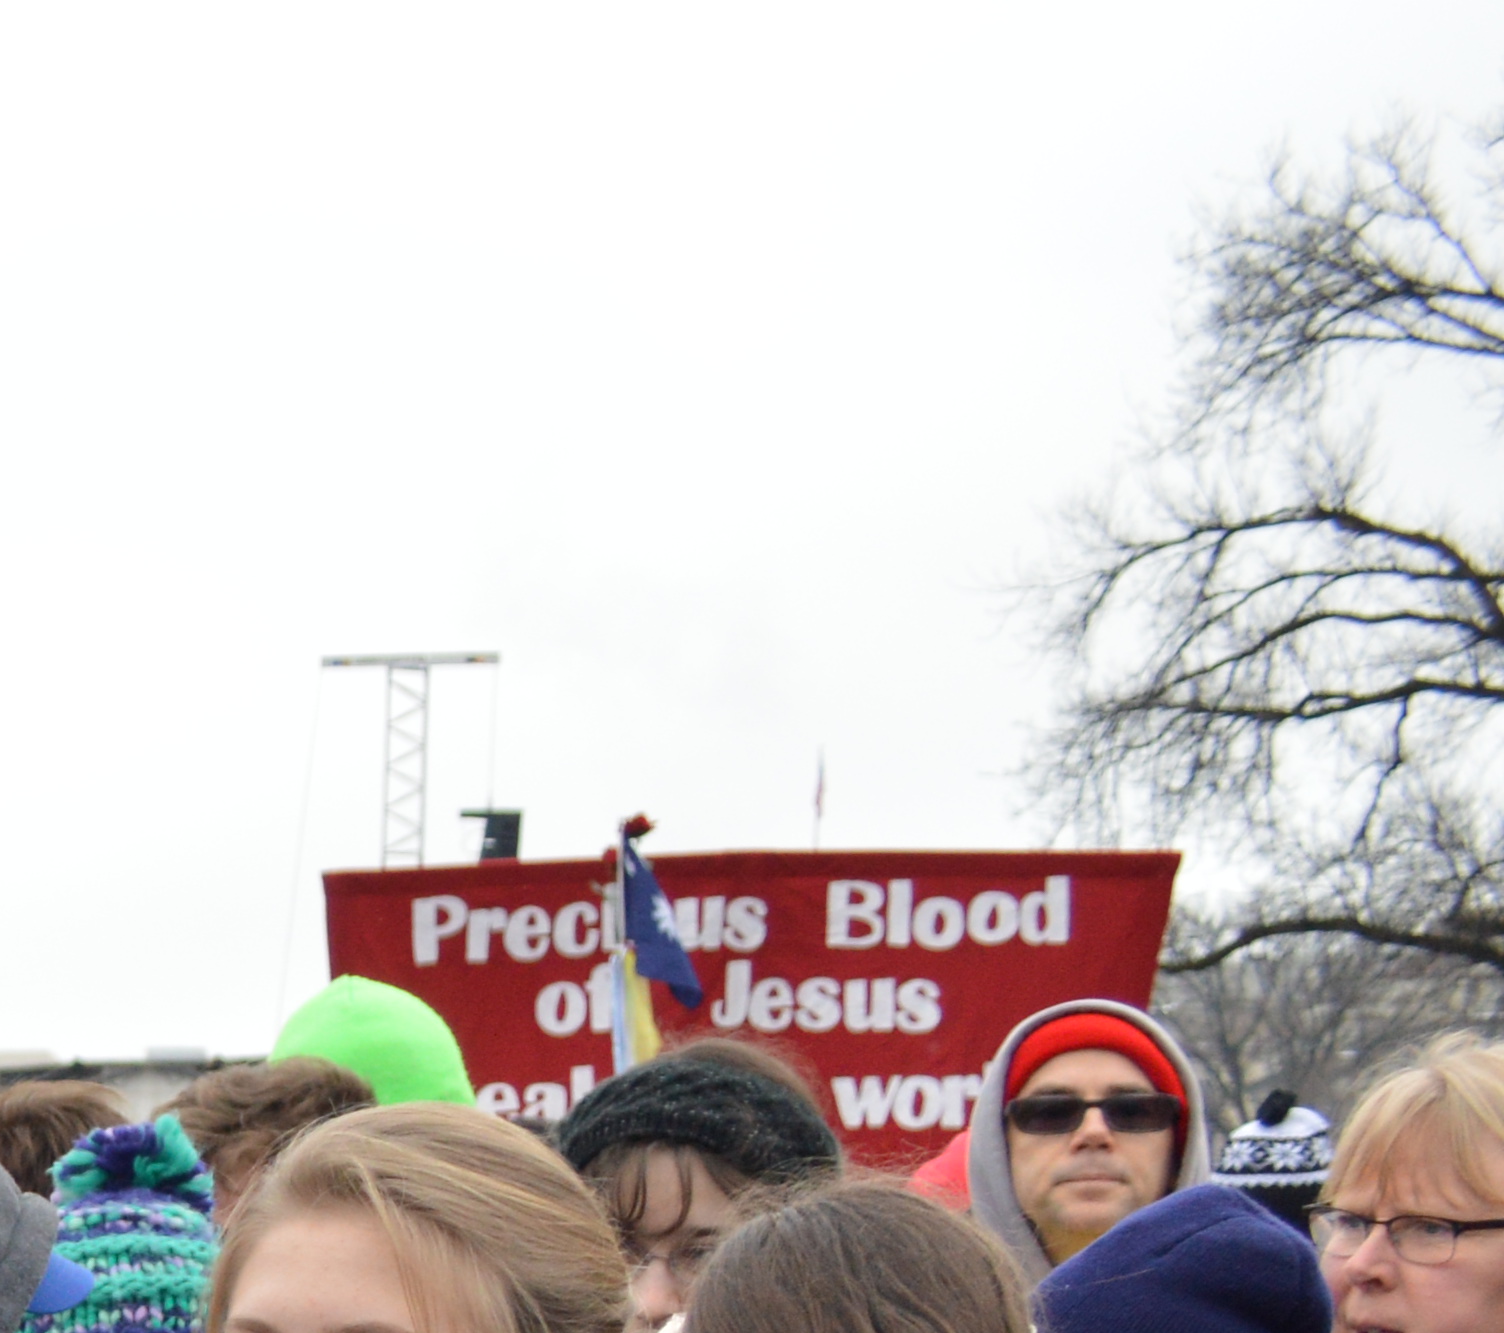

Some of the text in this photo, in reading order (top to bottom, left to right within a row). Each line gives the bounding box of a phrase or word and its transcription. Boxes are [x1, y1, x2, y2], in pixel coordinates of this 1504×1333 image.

[411, 874, 1071, 967] Precius Blood
[711, 958, 943, 1034] Jesus
[830, 1061, 991, 1131] wor
